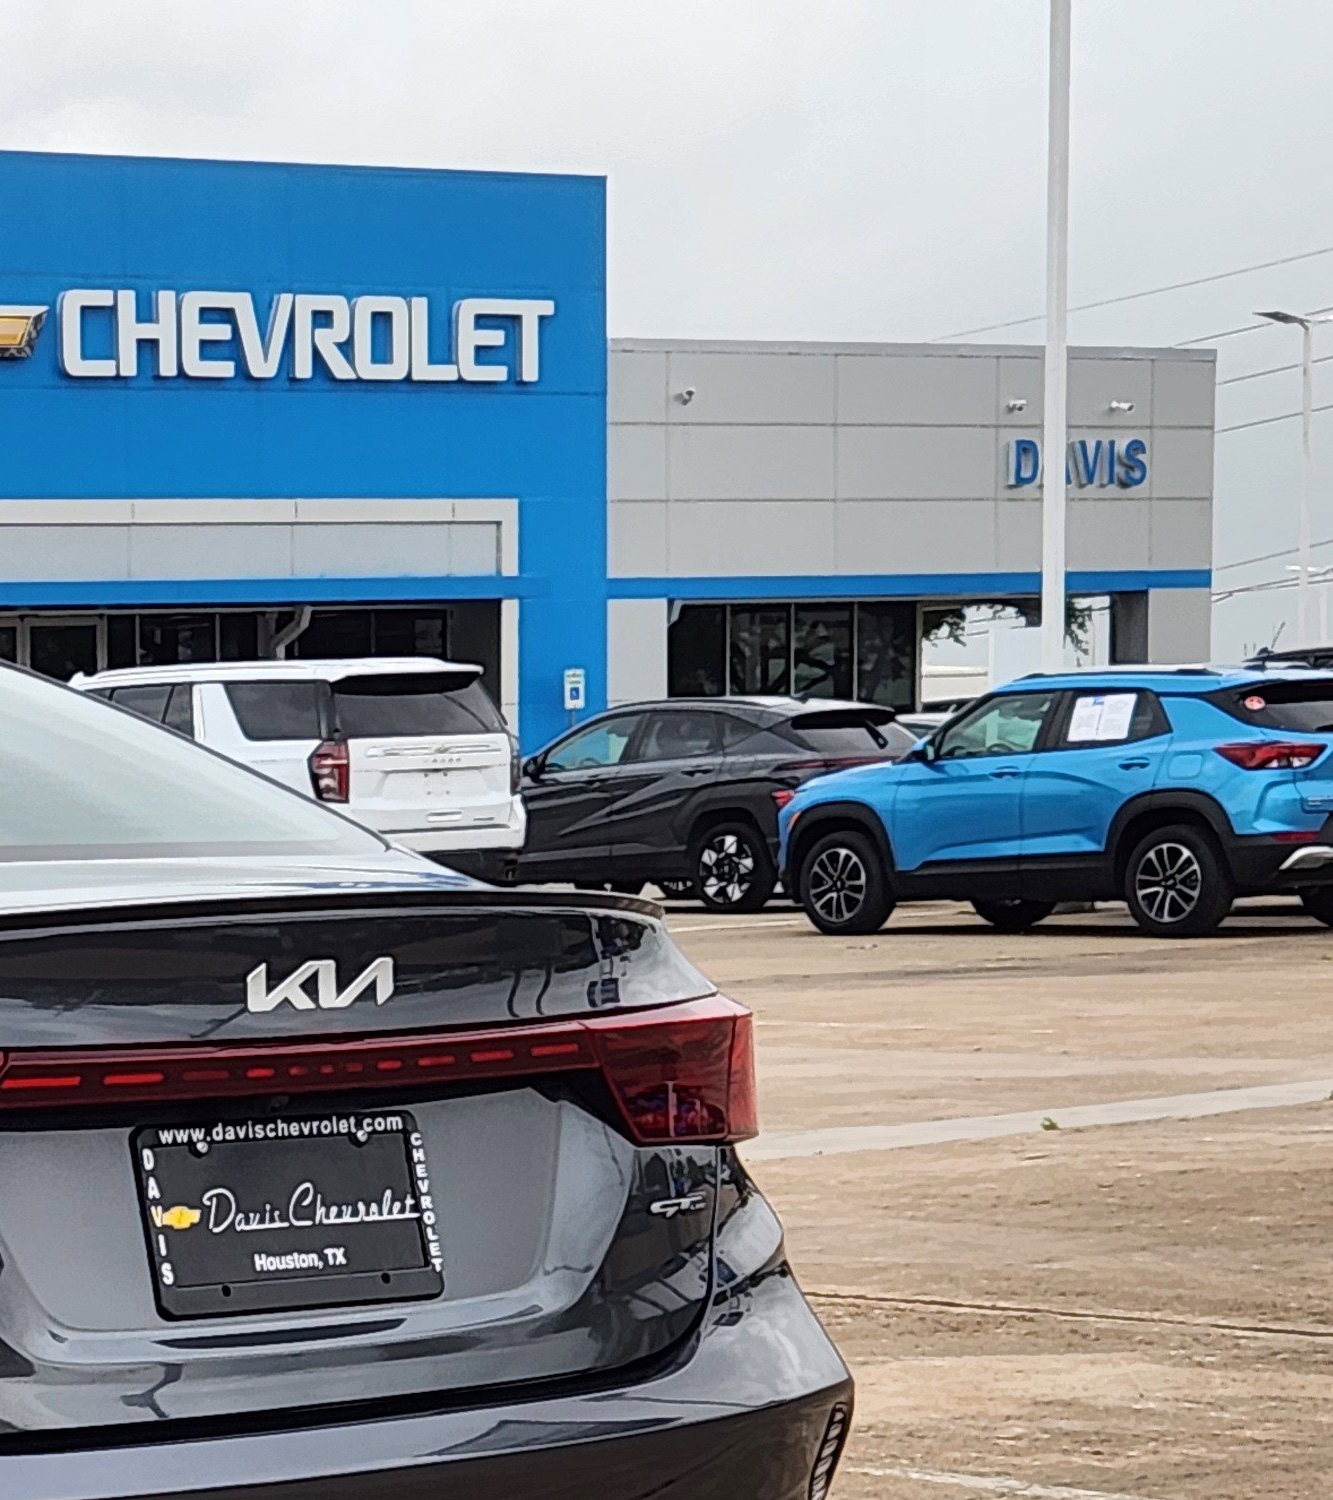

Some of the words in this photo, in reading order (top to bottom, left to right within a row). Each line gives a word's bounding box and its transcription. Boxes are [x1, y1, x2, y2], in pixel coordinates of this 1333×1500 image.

[57, 288, 556, 382] CHEVROLET
[1008, 438, 1148, 488] DVIS
[246, 956, 395, 1013] KIA
[158, 1114, 404, 1145] www.davischevrolet.com
[141, 1147, 174, 1286] DAVIS
[202, 1187, 290, 1233] Davis
[288, 1182, 421, 1226] Chevrolet
[410, 1132, 445, 1274] CHEVROLET
[253, 1250, 324, 1271] Houston,
[323, 1247, 347, 1266] TX
